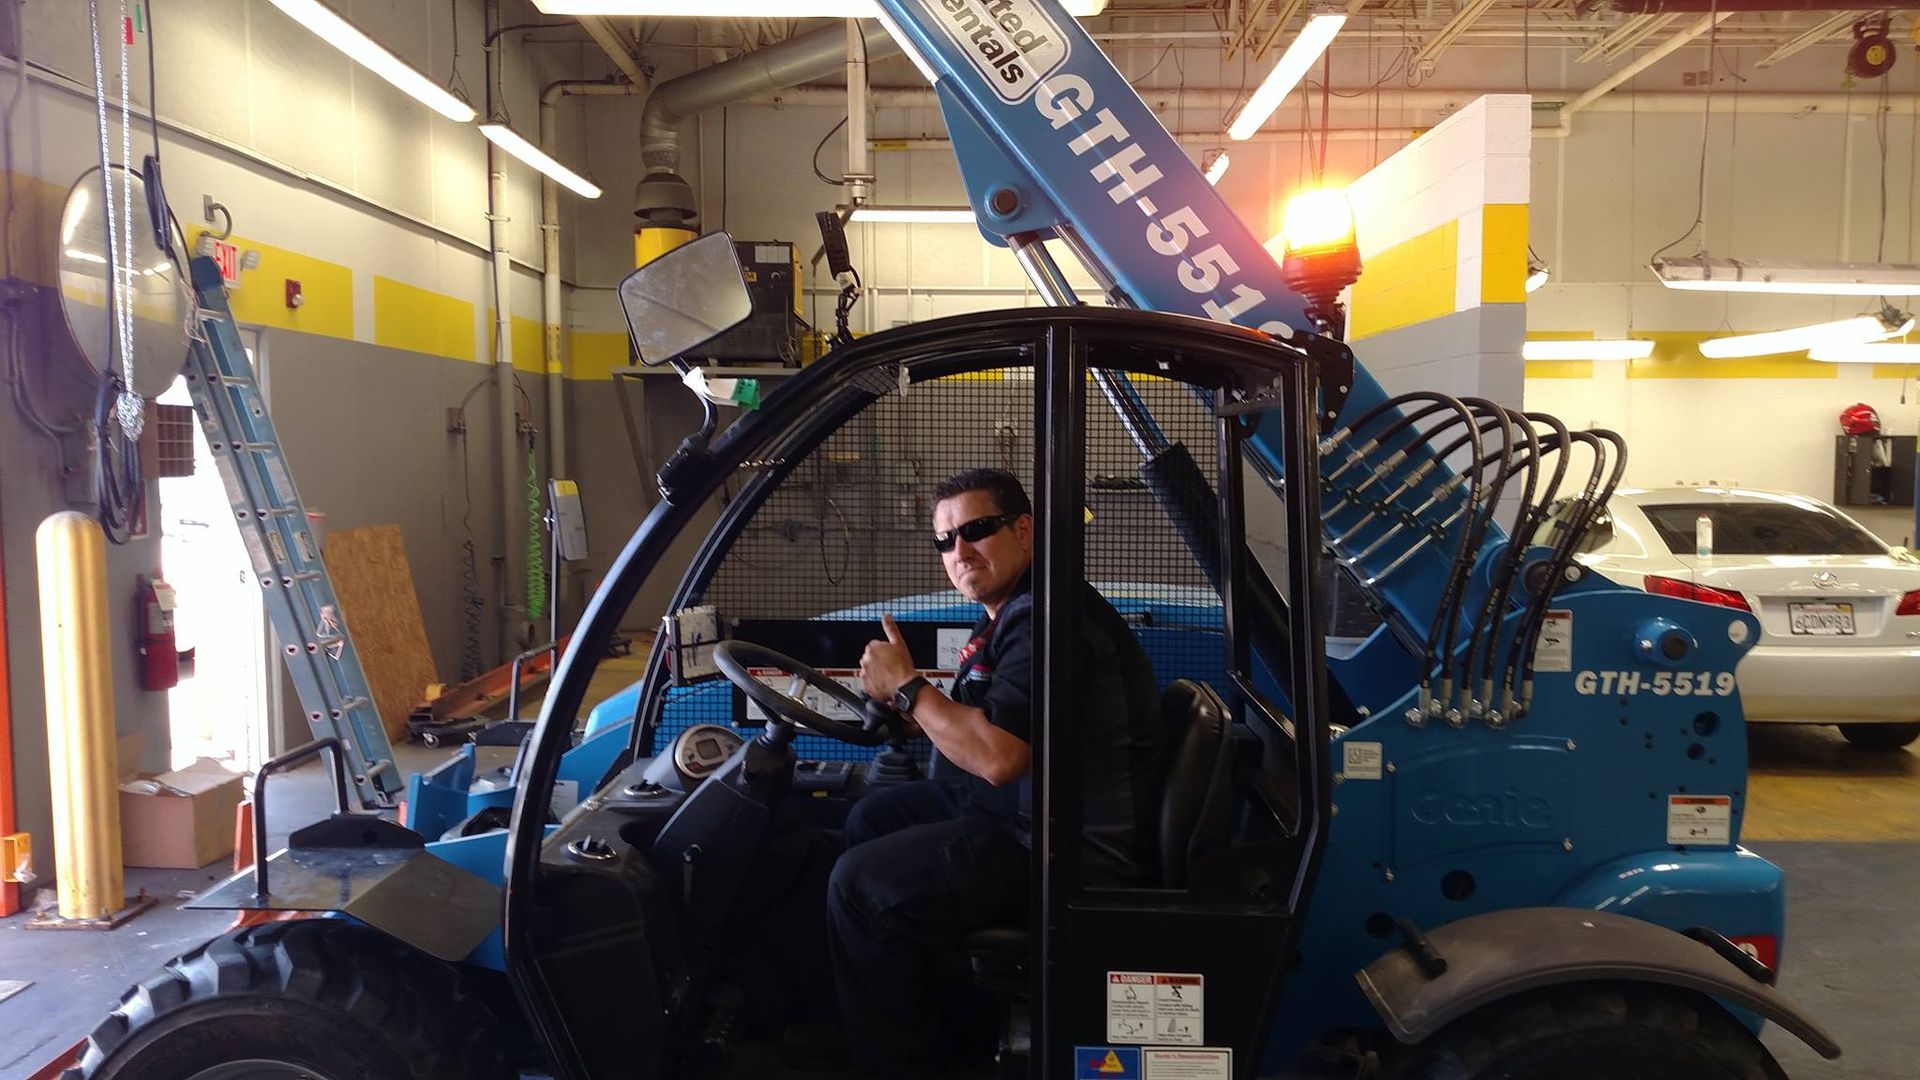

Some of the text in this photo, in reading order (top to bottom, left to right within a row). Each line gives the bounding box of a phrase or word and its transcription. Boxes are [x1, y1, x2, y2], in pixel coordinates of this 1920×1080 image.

[1574, 670, 1736, 697] GTH-5519
[1409, 785, 1552, 830] Genie
[1120, 975, 1153, 985] DANGER
